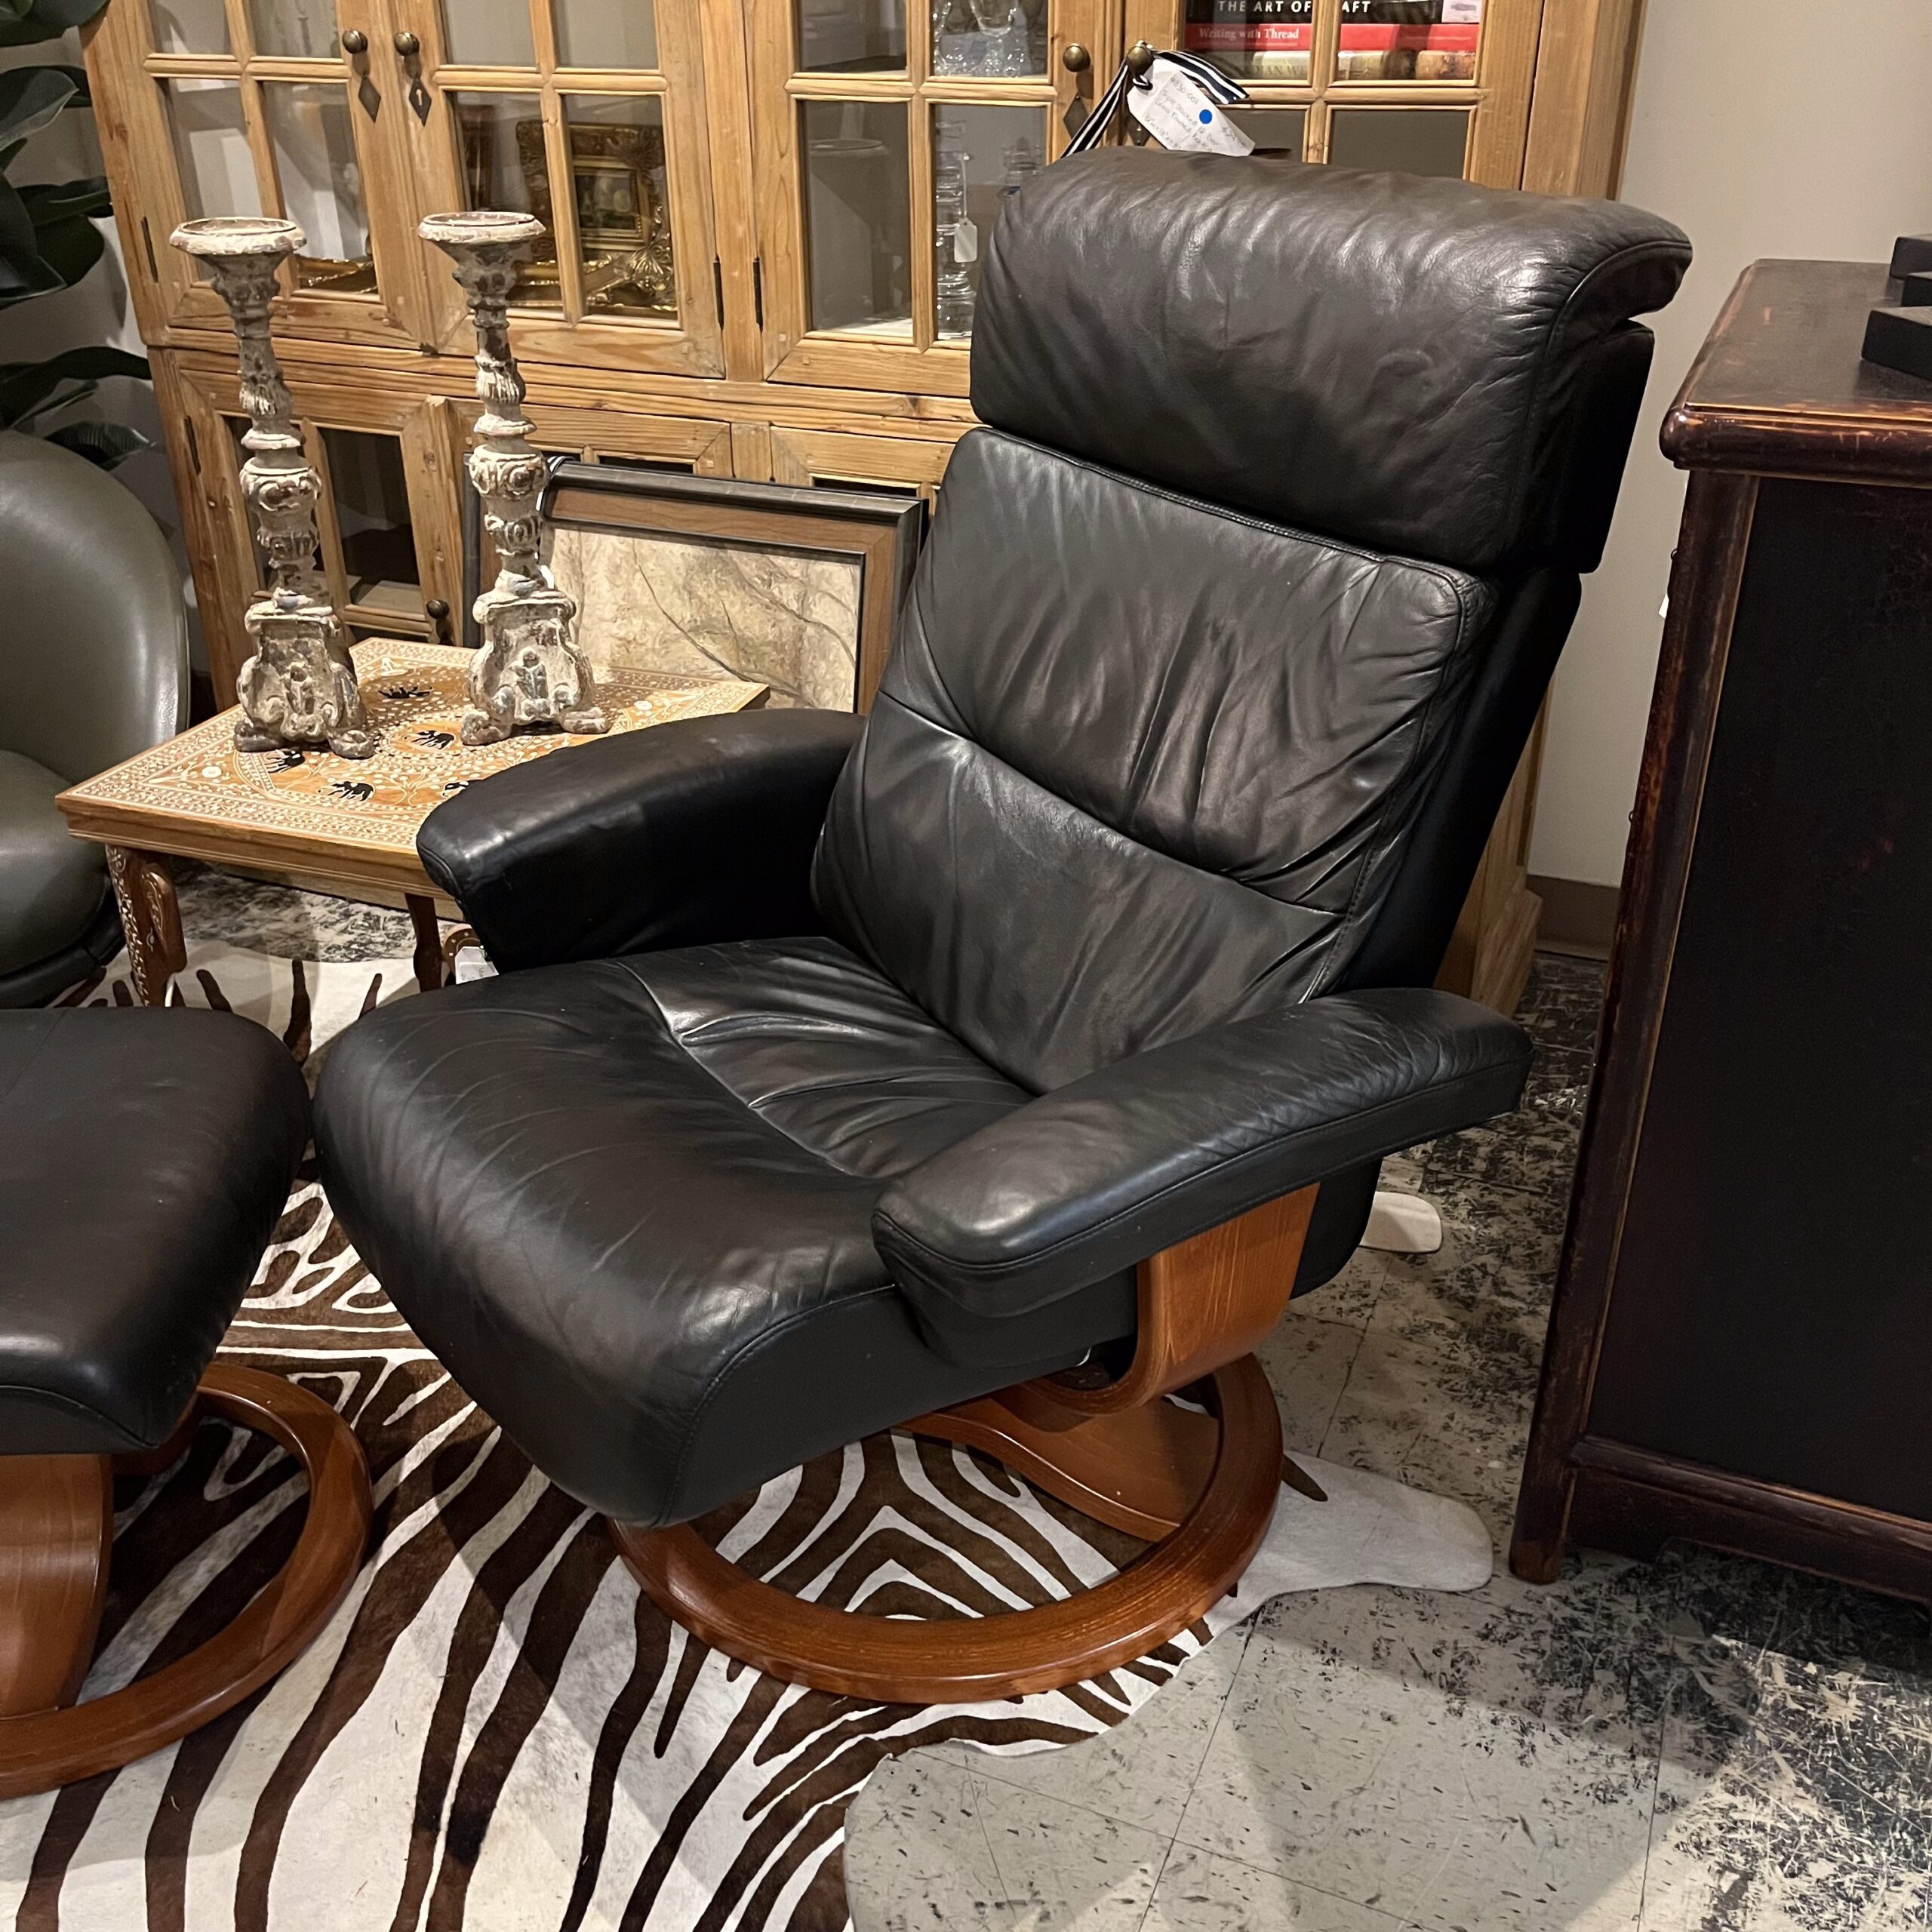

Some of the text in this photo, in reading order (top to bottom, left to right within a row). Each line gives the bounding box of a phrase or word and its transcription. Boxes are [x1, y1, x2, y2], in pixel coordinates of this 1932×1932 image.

[1219, 1, 1371, 13] THE ART OF AFT
[1200, 28, 1300, 41] Writing with Thread
